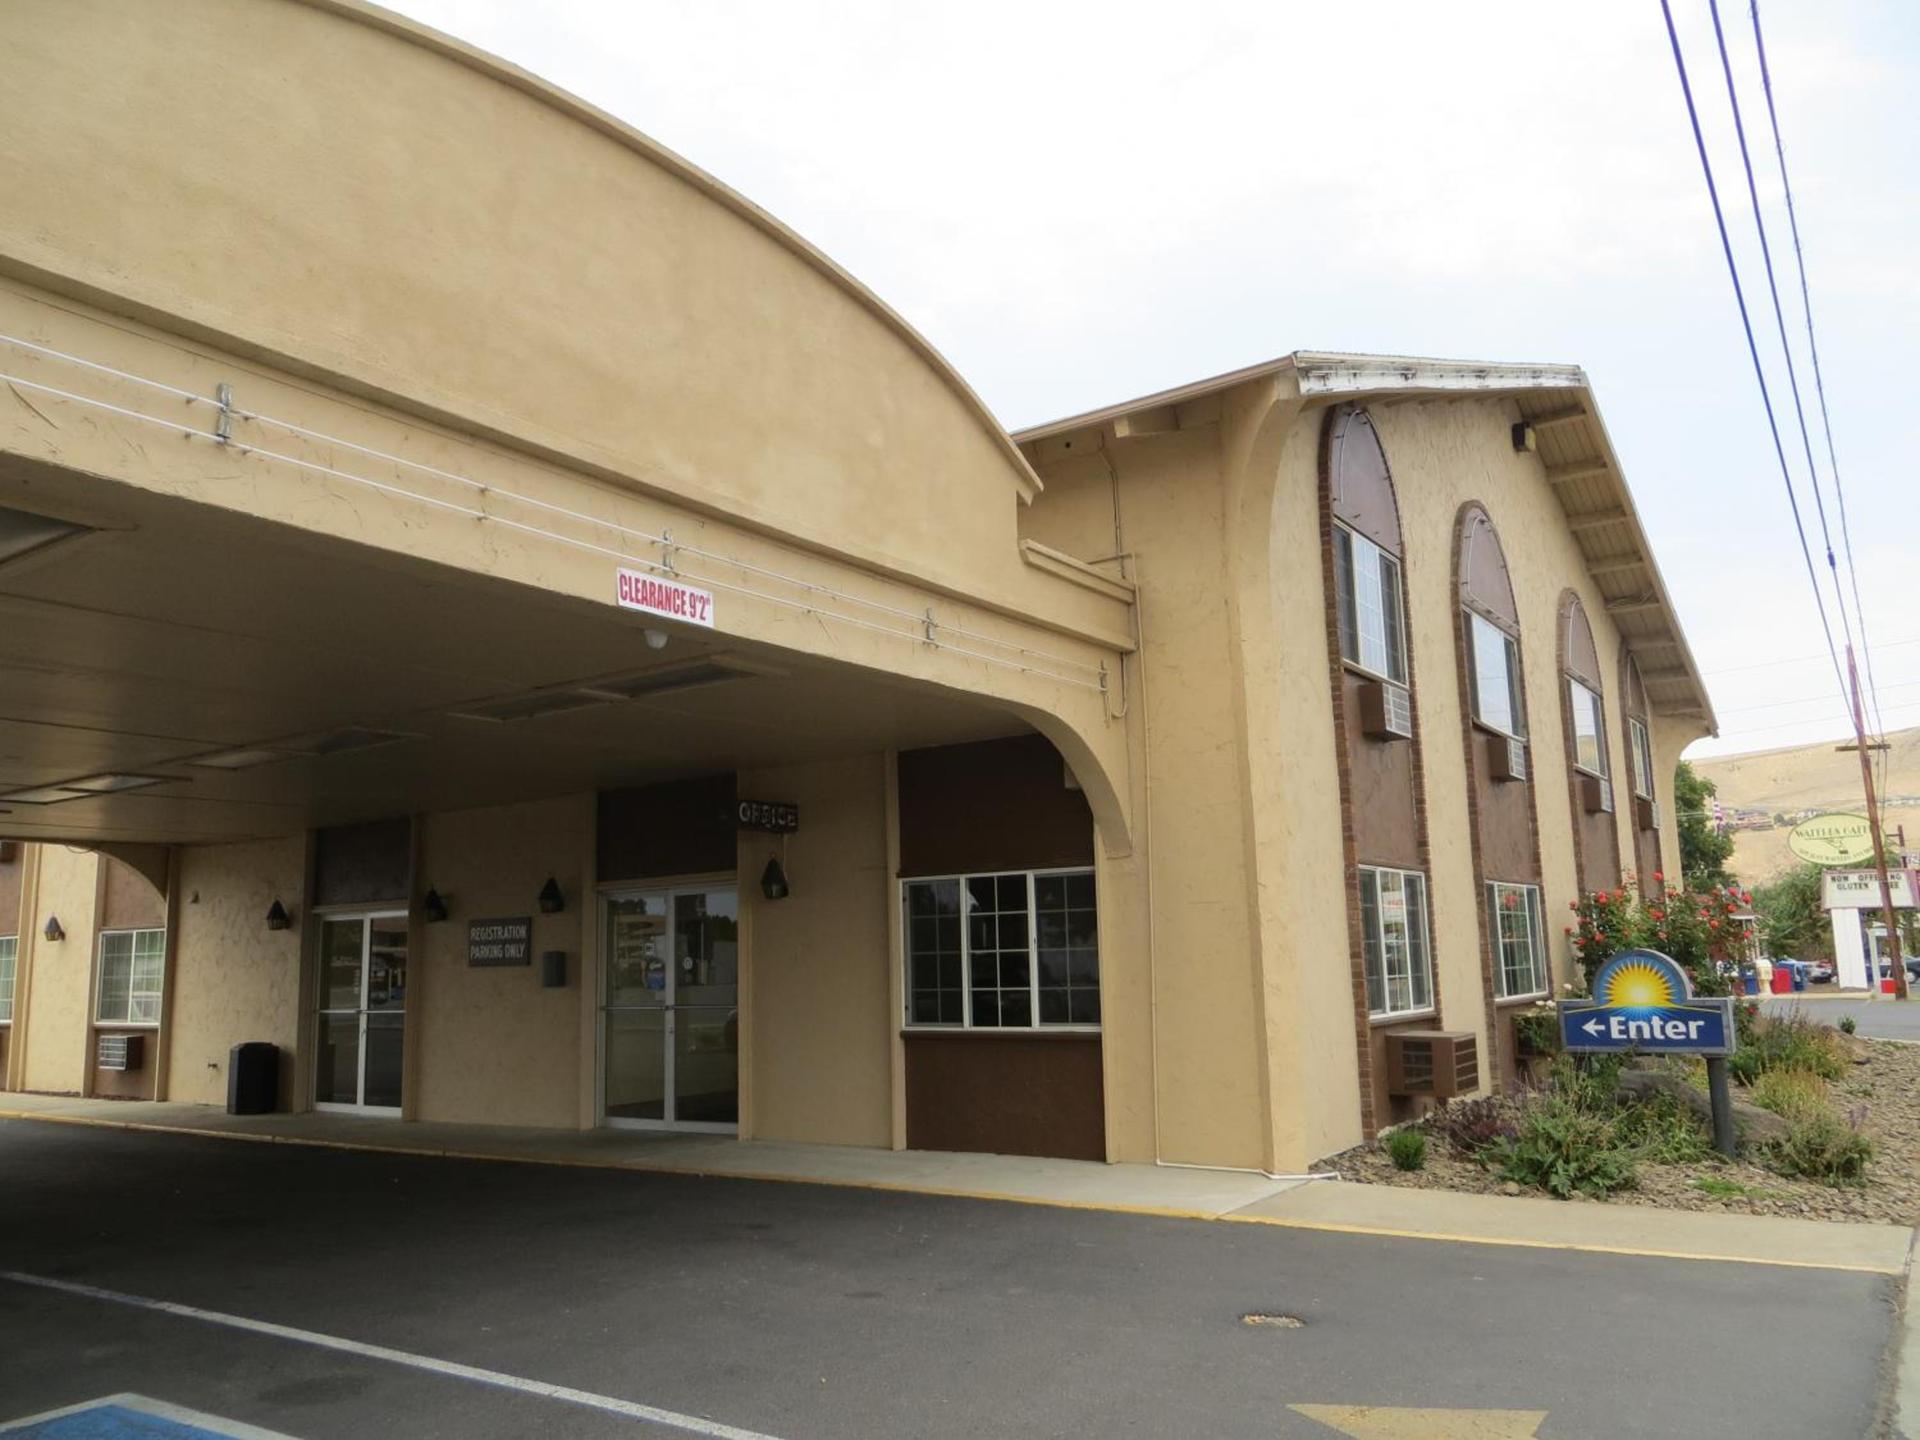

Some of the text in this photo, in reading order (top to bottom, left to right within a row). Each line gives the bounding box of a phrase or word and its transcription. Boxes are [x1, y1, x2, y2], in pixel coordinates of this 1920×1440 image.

[619, 573, 687, 617] CLEARANCE
[739, 802, 797, 827] OFFICE
[1836, 882, 1869, 890] GLUTEN
[1858, 873, 1902, 882] OFFENG
[470, 925, 527, 941] REGISTRATION
[470, 943, 526, 960] PARKING ONLY
[1609, 1015, 1705, 1040] Enter
